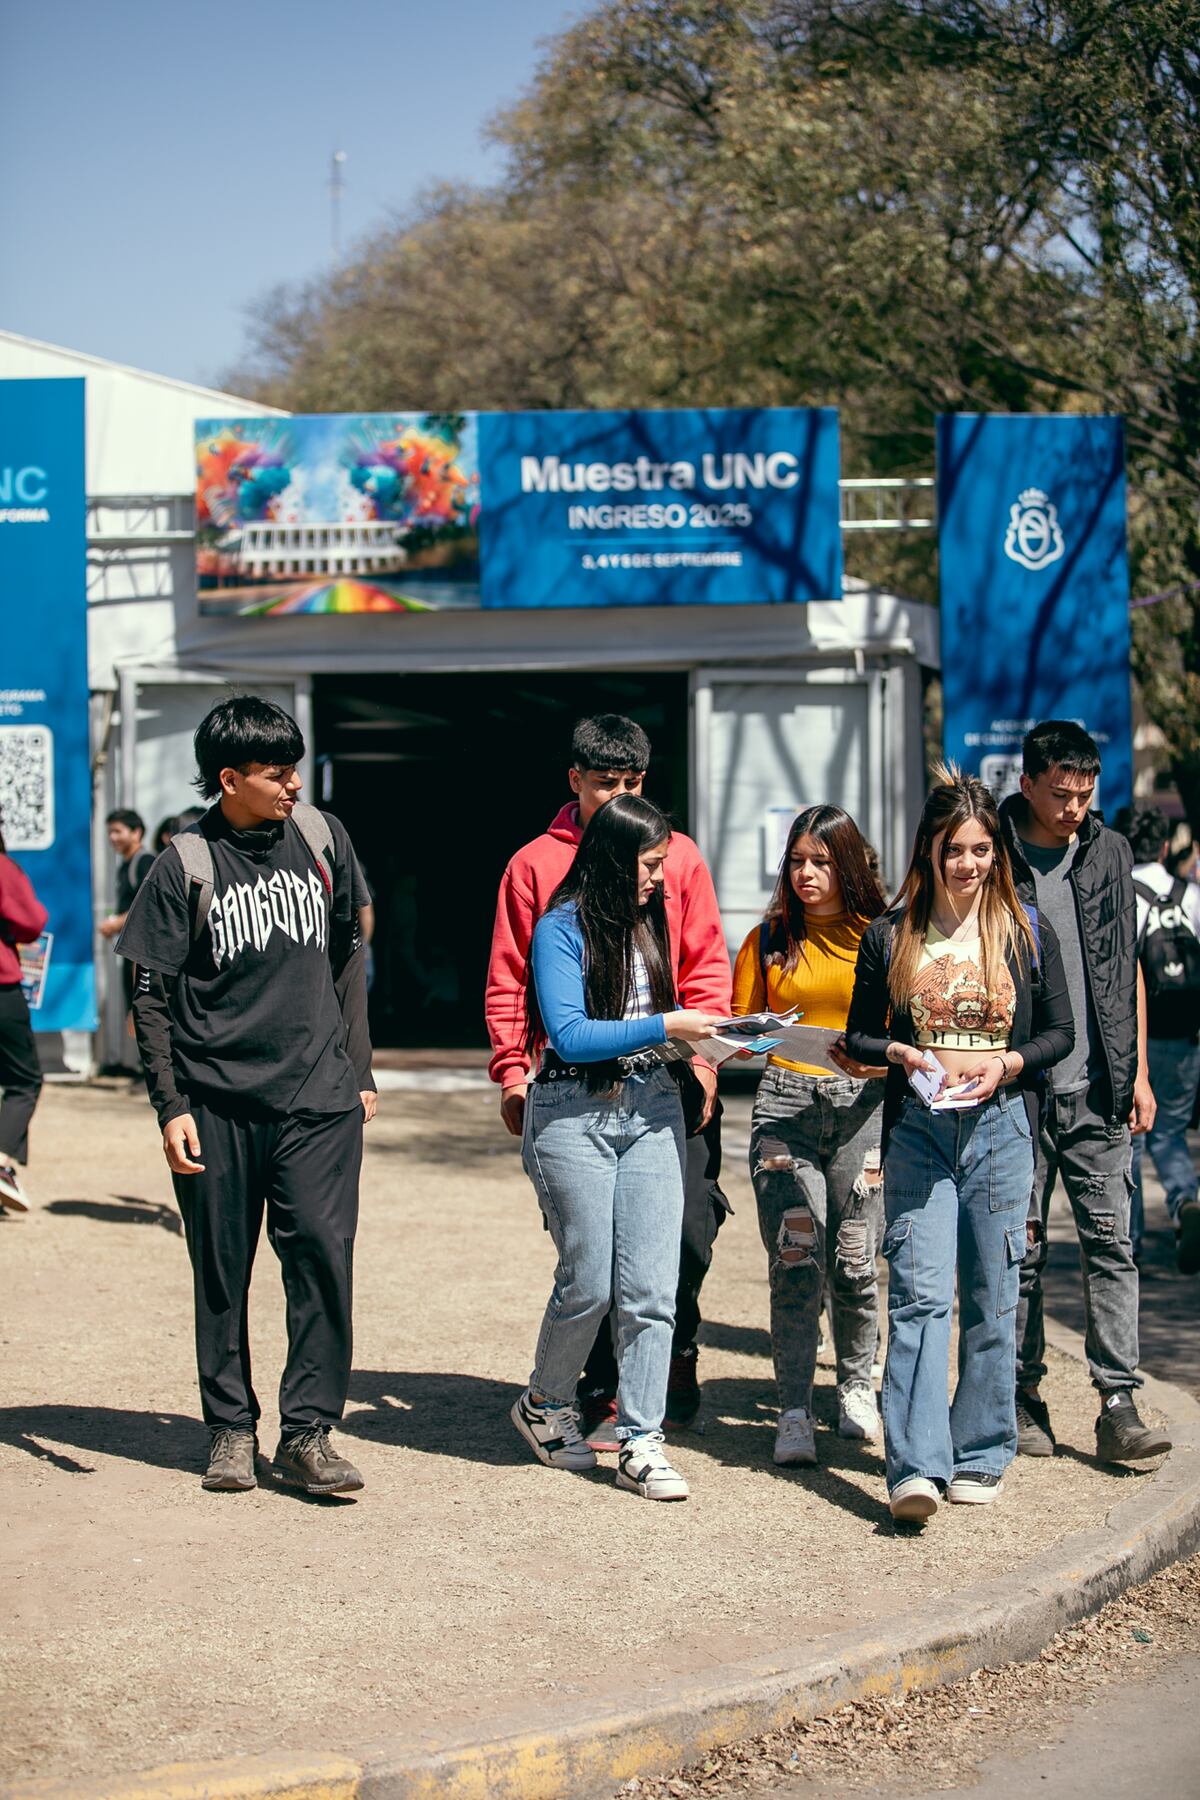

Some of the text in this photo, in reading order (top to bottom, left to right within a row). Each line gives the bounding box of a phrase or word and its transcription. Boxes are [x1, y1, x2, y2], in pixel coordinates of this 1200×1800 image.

[520, 451, 800, 492] Muestra UNC
[568, 502, 752, 530] INGRESO 2025
[653, 551, 743, 568] SEPTIEMBRE
[207, 867, 326, 972] GANGSTER
